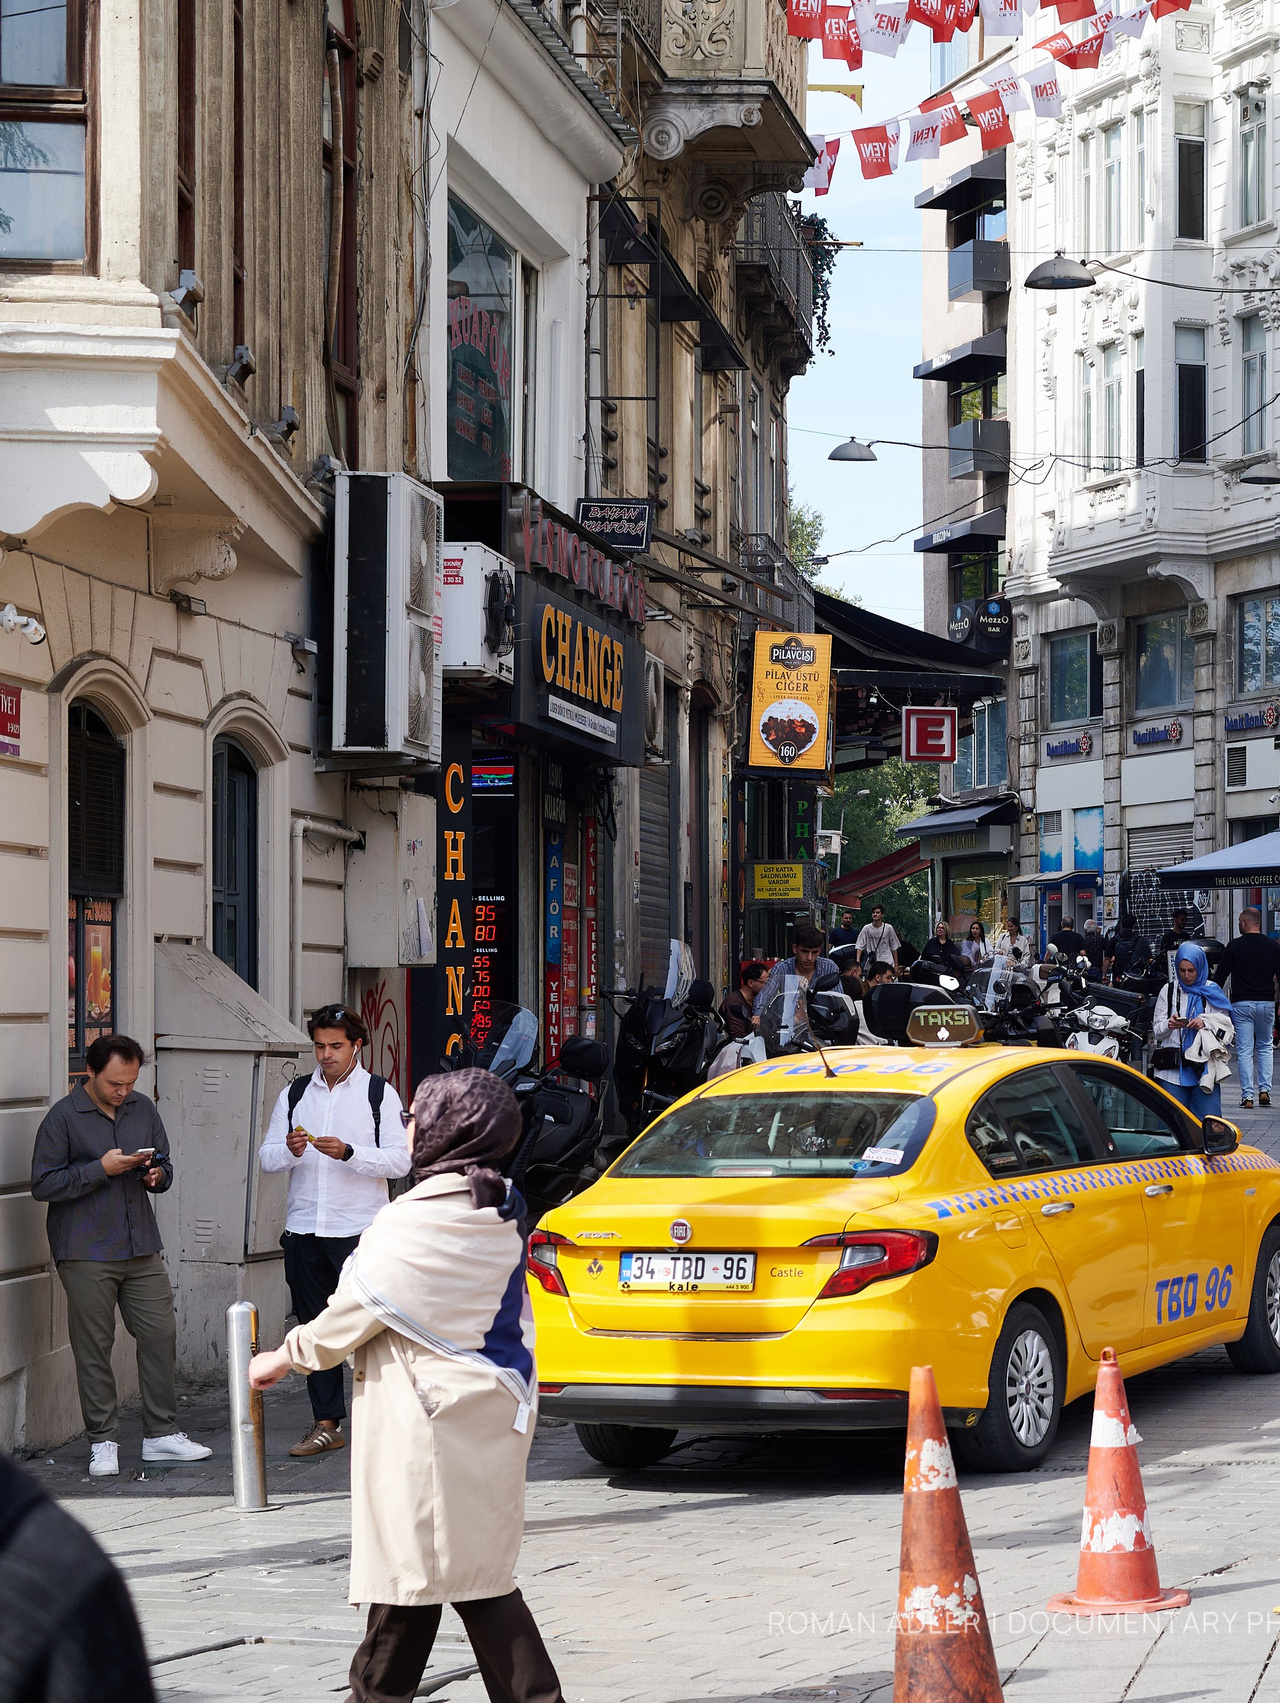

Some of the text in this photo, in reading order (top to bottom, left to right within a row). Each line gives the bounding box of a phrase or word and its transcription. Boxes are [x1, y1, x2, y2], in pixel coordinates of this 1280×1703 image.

[449, 295, 511, 400] KUAFÖR
[588, 506, 639, 520] BAYAN
[443, 560, 462, 568] EKNİK
[541, 603, 624, 714] CHANGE
[765, 669, 820, 682] PİLAV ÜSTÜ
[776, 679, 809, 692] CİĞER
[0, 690, 17, 716] İYET
[916, 717, 945, 753] E
[780, 745, 796, 757] 160
[549, 832, 560, 938] UAFÖR
[1215, 875, 1273, 886] THE ITALIAN COFFEE
[475, 905, 496, 921] 95
[475, 925, 497, 941] 80
[549, 981, 560, 1057] YEMİNLİ
[755, 1062, 953, 1077] TBD 96
[673, 1225, 689, 1238] FIAT
[622, 1256, 748, 1280] TR 34 TBD 96
[770, 1267, 804, 1278] Castle
[668, 1281, 699, 1292] kale
[1155, 1264, 1233, 1325] TBD 96
